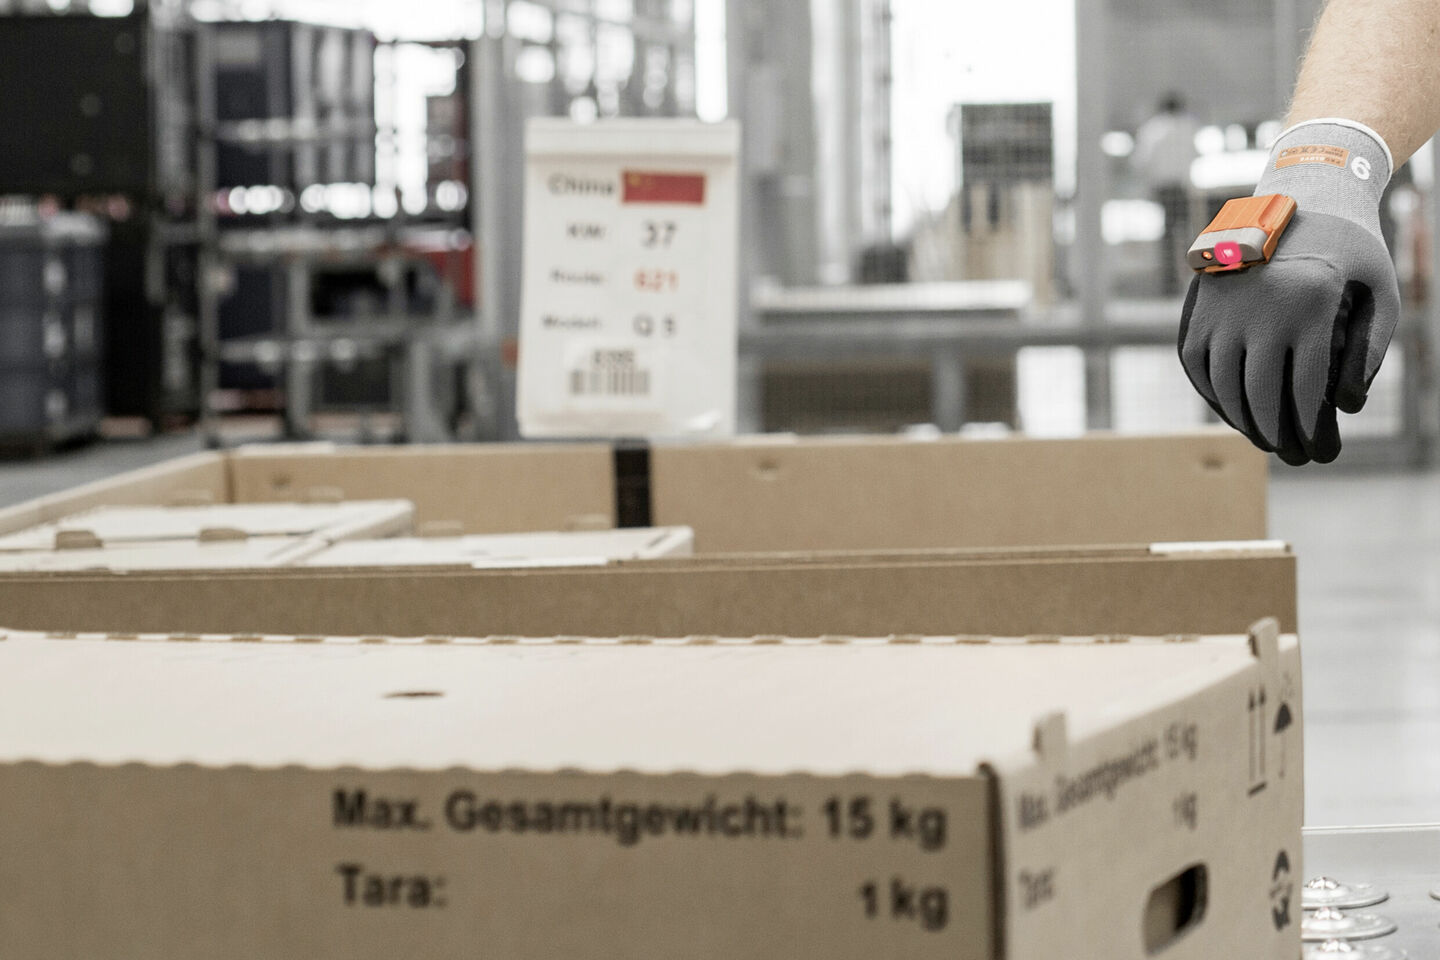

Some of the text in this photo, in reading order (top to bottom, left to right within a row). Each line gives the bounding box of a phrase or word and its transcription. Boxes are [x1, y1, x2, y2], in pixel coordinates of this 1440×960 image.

[548, 172, 615, 197] China
[642, 219, 677, 249] 37
[634, 268, 679, 292] 621
[332, 788, 949, 853] Max. Gesamtgewicht: 15 kg
[335, 862, 951, 933] Tara: 1 kg
